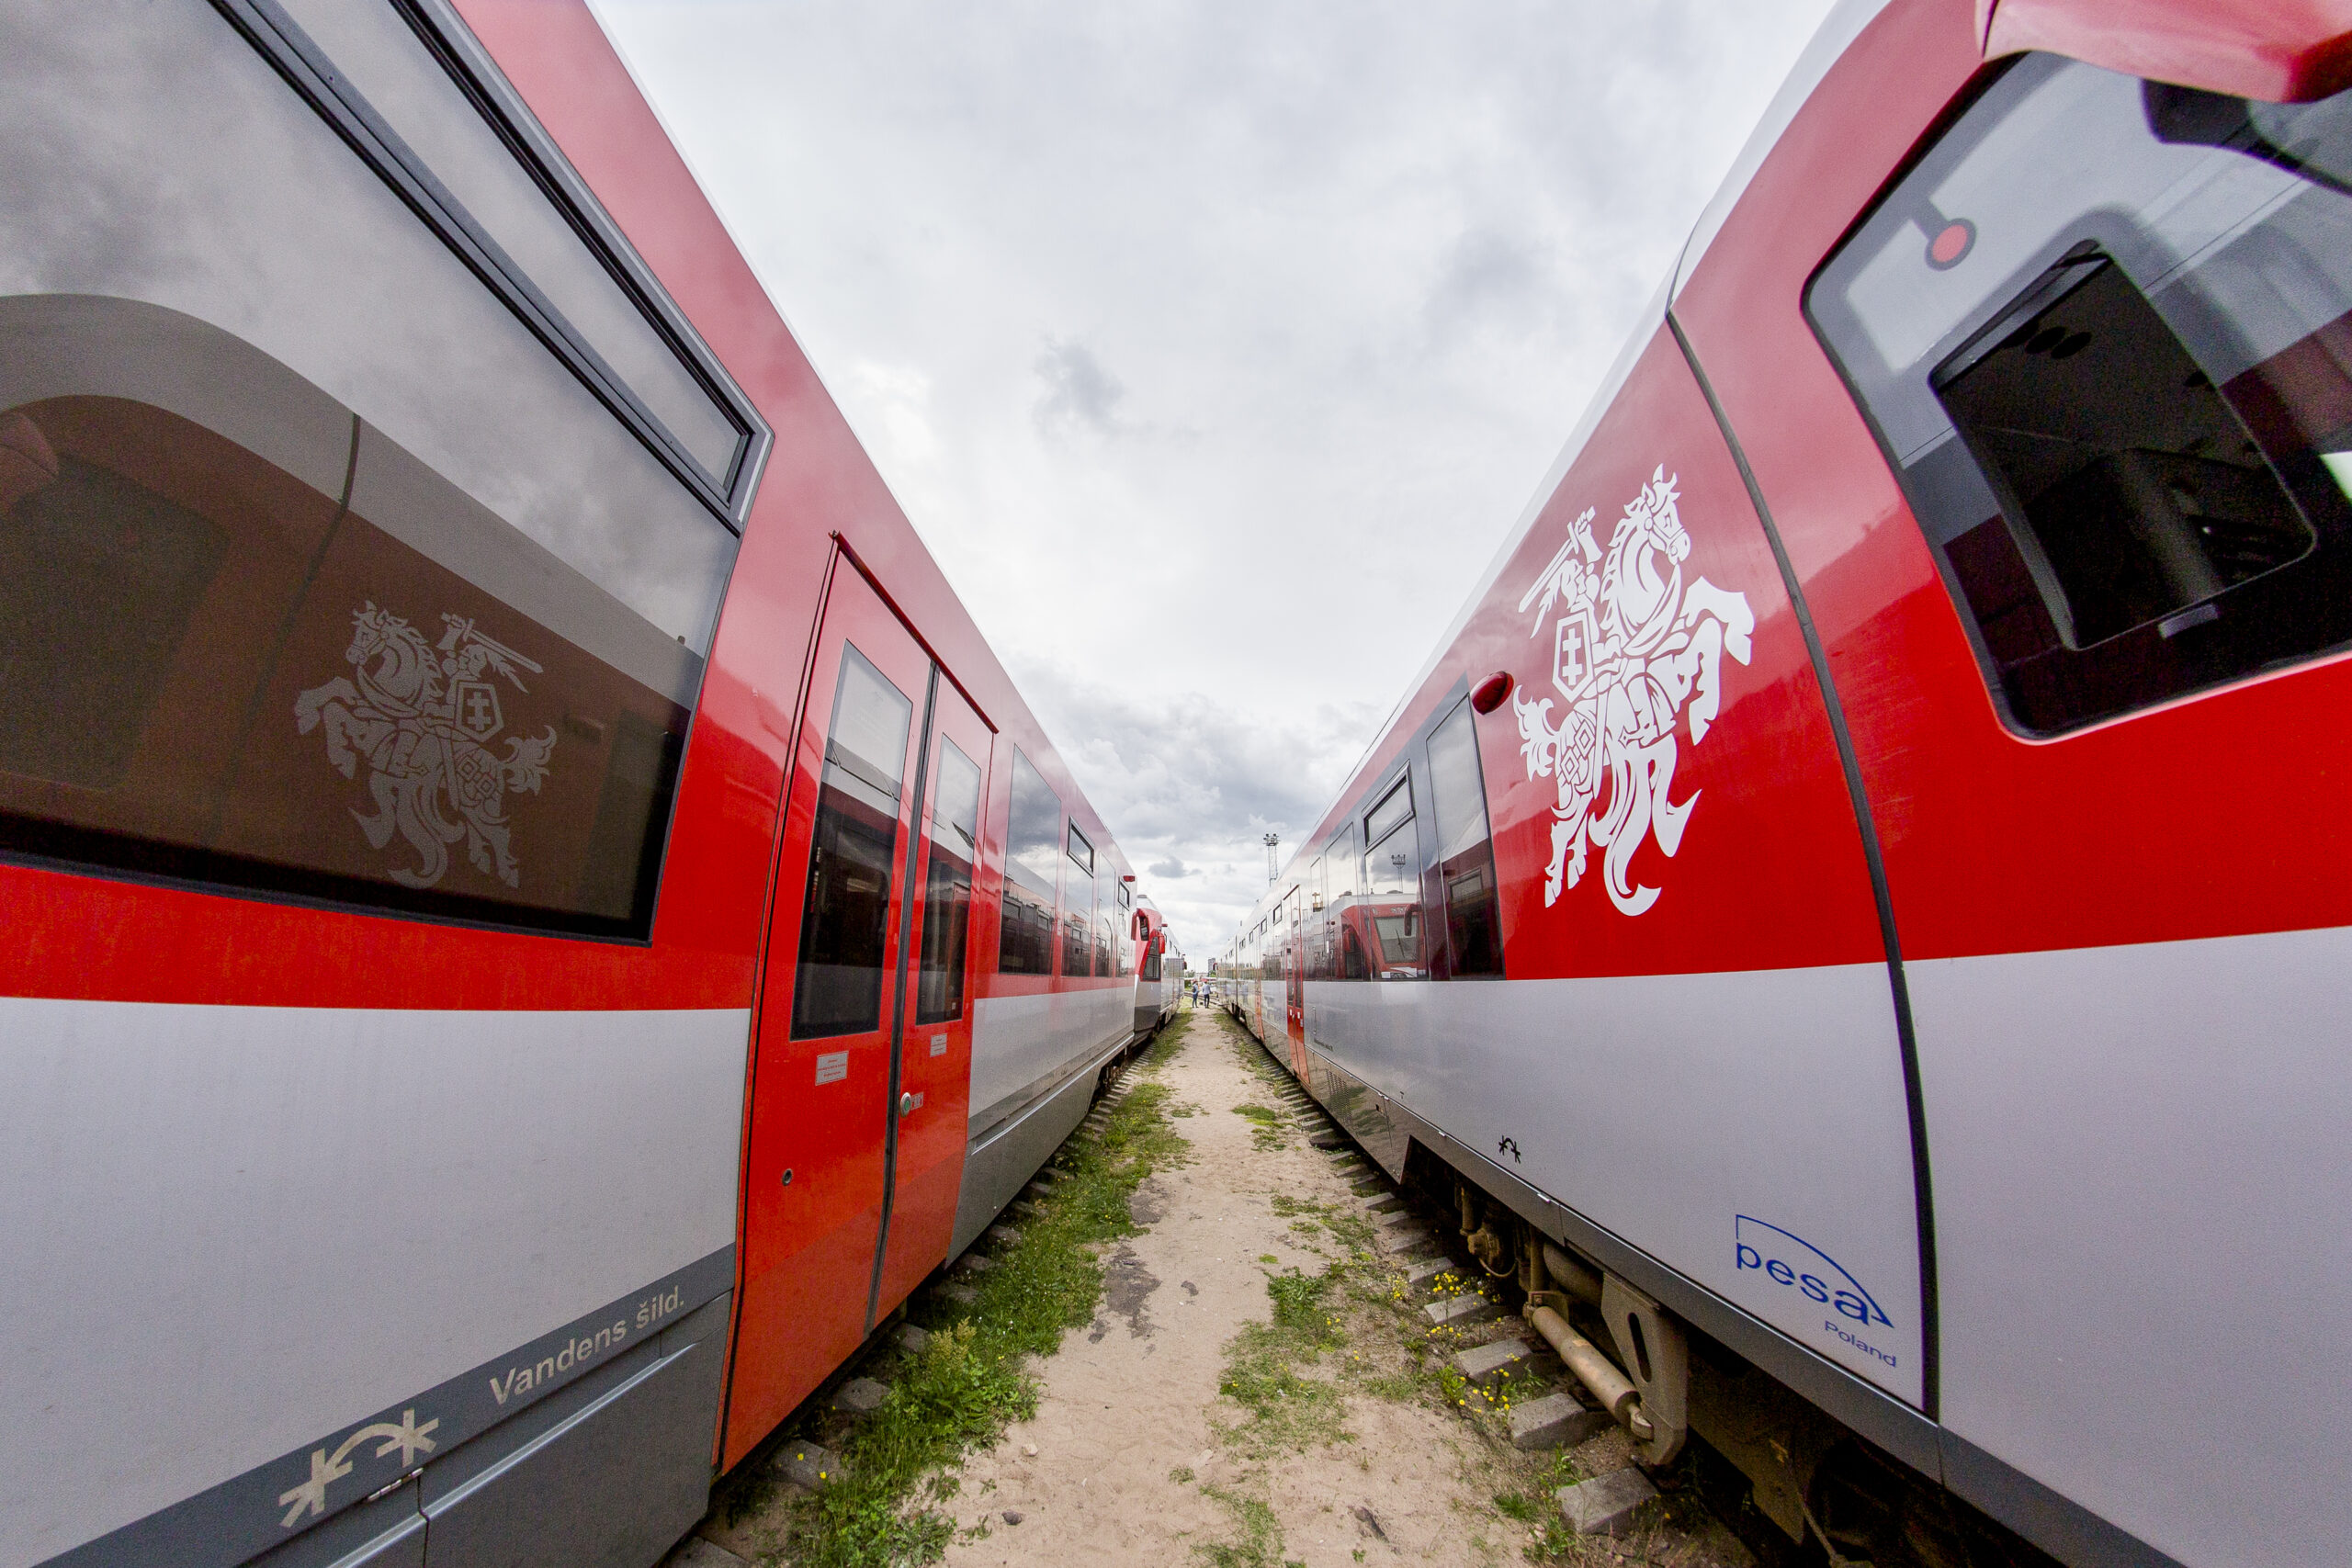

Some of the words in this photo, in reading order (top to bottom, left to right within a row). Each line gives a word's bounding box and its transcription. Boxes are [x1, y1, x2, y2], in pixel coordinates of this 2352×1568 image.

[1736, 1243, 1870, 1325] pesa
[490, 1320, 627, 1405] Vandens
[636, 1285, 684, 1329] šild.
[1825, 1320, 1897, 1368] Poland
